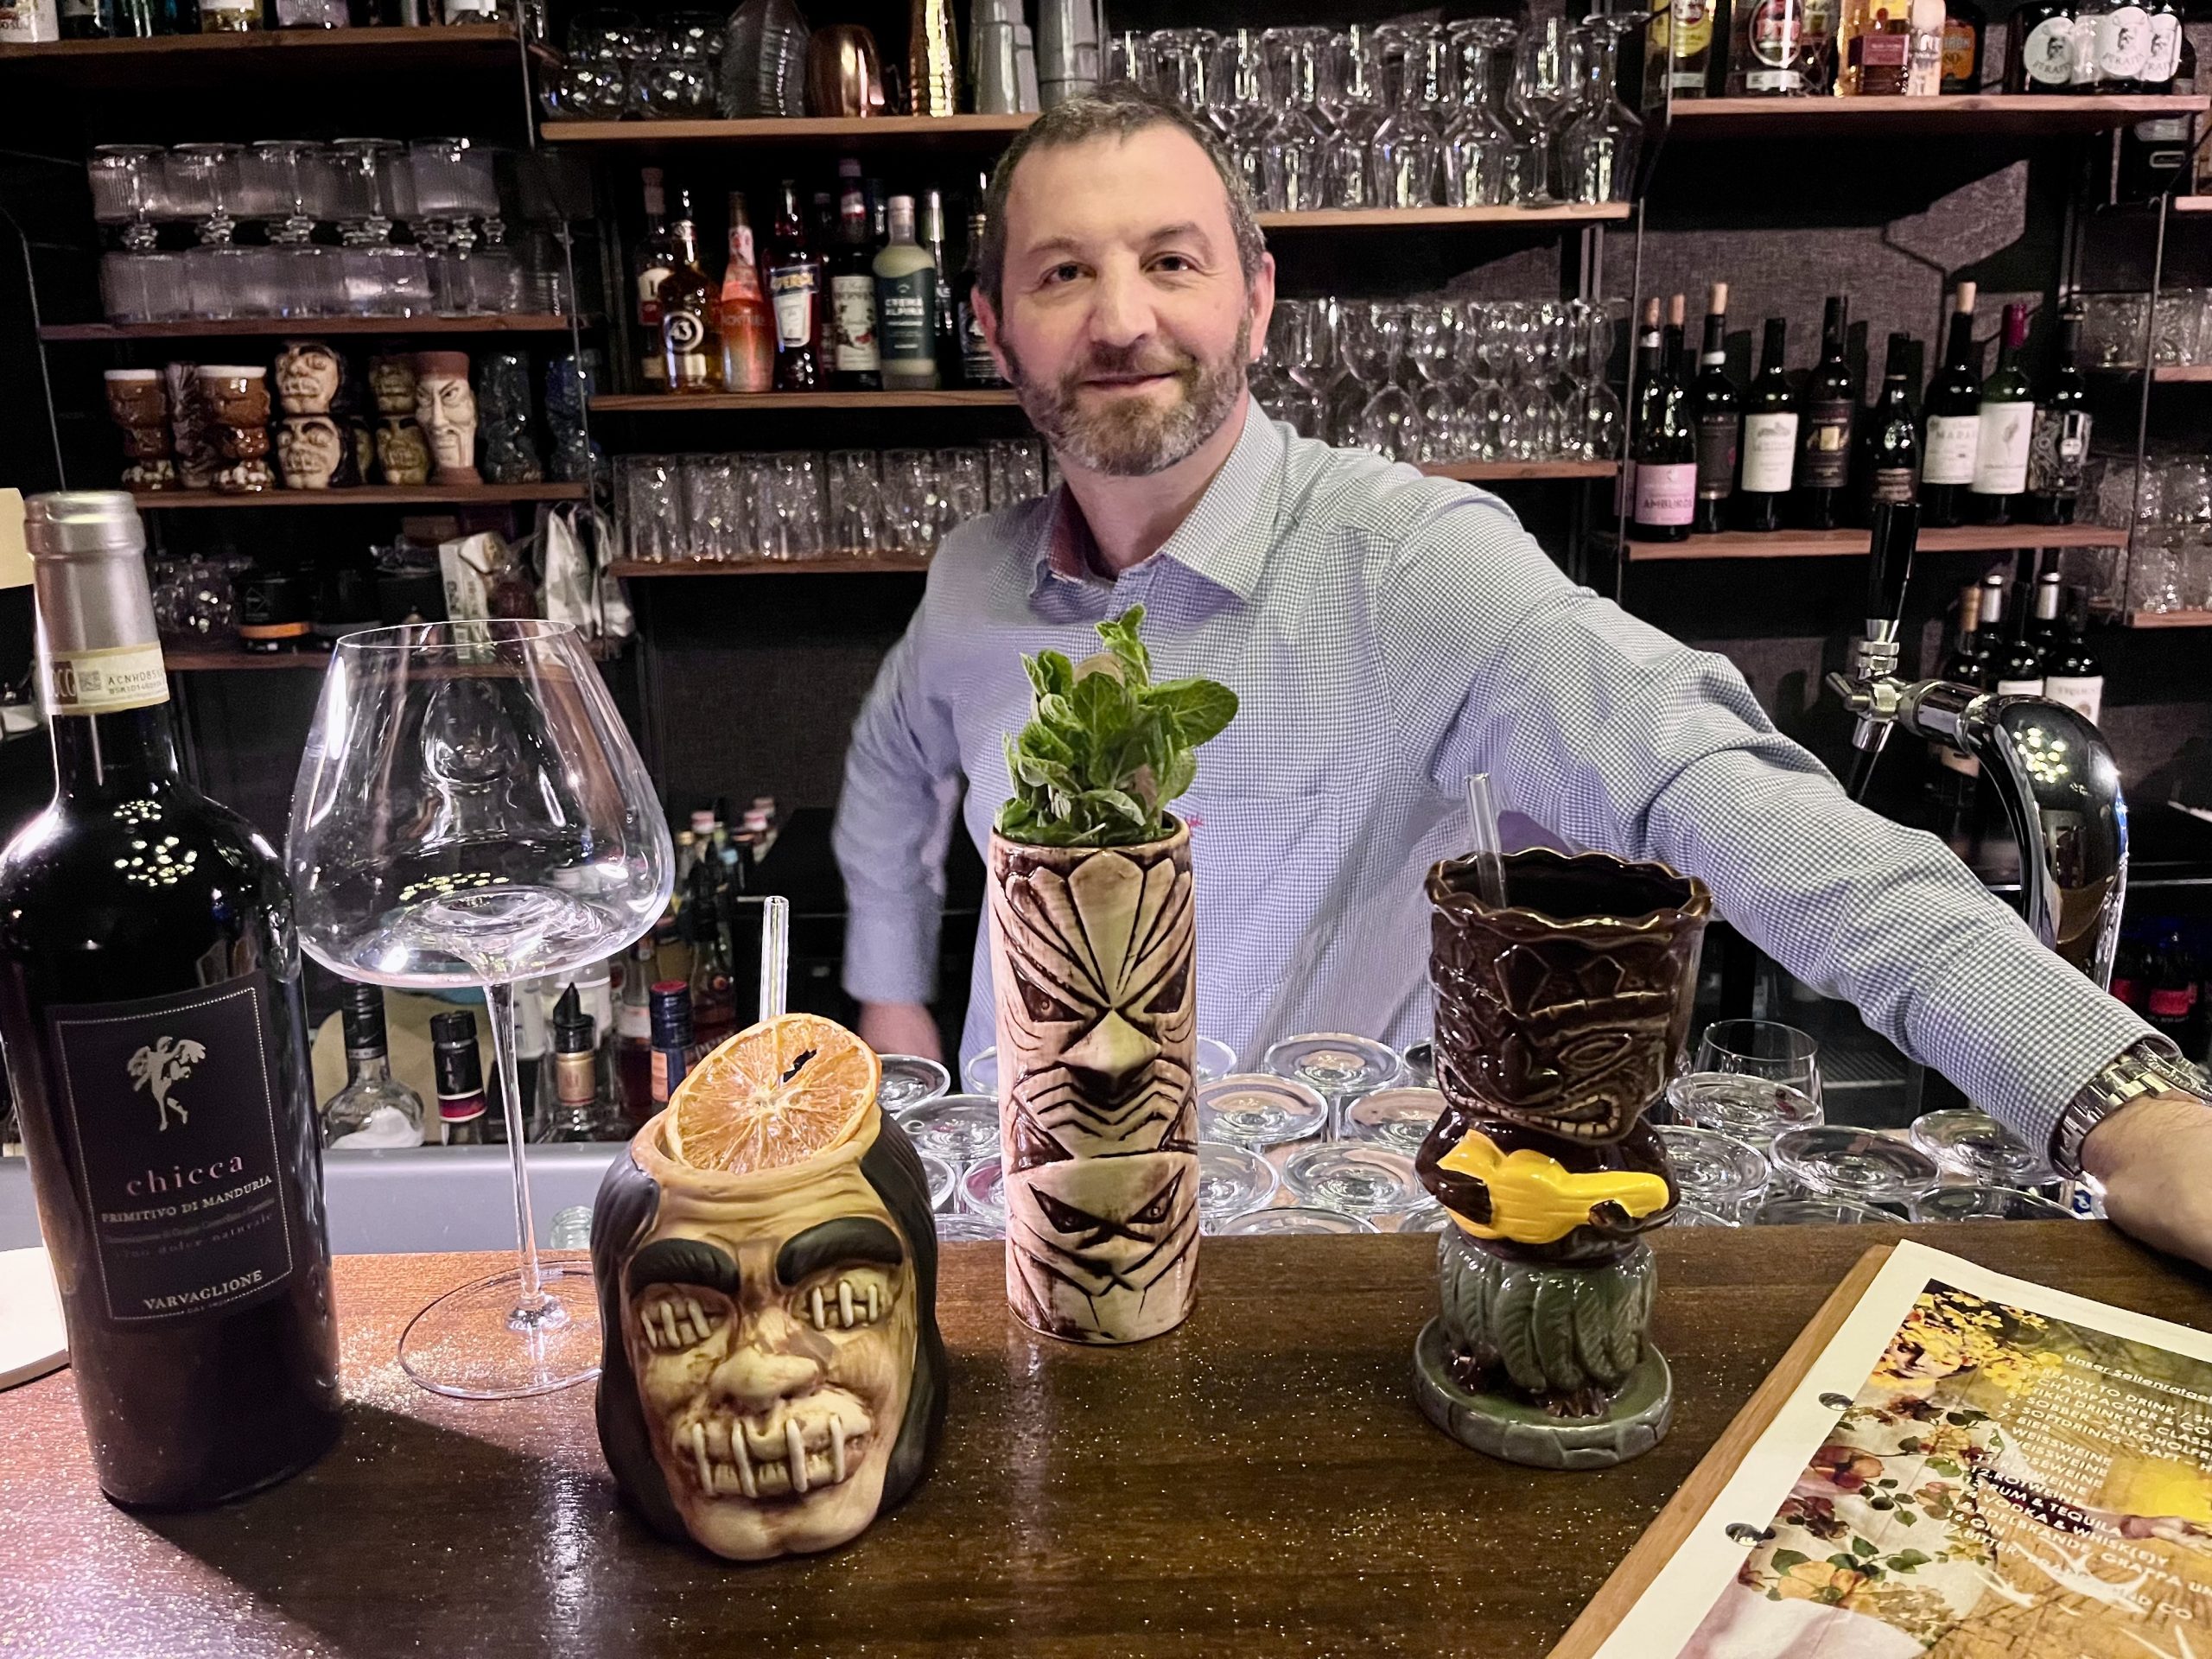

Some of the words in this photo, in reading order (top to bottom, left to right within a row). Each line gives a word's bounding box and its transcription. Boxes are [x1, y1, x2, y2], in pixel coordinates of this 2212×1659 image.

[126, 1155, 243, 1196] chicca
[101, 1206, 177, 1223] PRIMITIVO
[181, 1201, 199, 1214] DI
[202, 1175, 273, 1208] MANDURIA
[143, 1269, 264, 1310] VARVAGLIONE
[2065, 1353, 2110, 1374] Unser
[2026, 1396, 2090, 1422] SOBBER
[2031, 1385, 2071, 1404] TIKKI
[2074, 1400, 2133, 1426] DRINKS
[2137, 1421, 2150, 1431] &
[2037, 1377, 2158, 1421] CHAMPAGNER
[2162, 1416, 2174, 1427] &
[2179, 1421, 2210, 1436] CO
[2042, 1368, 2095, 1389] READY
[2100, 1385, 2121, 1397] TO
[2126, 1394, 2177, 1415] DRINK
[2016, 1416, 2051, 1433] BIER
[2021, 1406, 2121, 1445] SOFTDRINKS
[2139, 1445, 2181, 1462] SAFT
[2012, 1427, 2114, 1466] WEISSWEINE
[1970, 1517, 2005, 1536] GIN
[1984, 1493, 2048, 1524] VODKA
[2053, 1519, 2066, 1530] &
[2073, 1525, 2169, 1567] WHISK(E)Y
[2031, 1497, 2044, 1509] &
[2050, 1503, 2123, 1538] TEQUILA
[1963, 1529, 2018, 1556] BITTER
[2101, 1552, 2182, 1587] GRAPPA
[2158, 1601, 2194, 1620] CO
